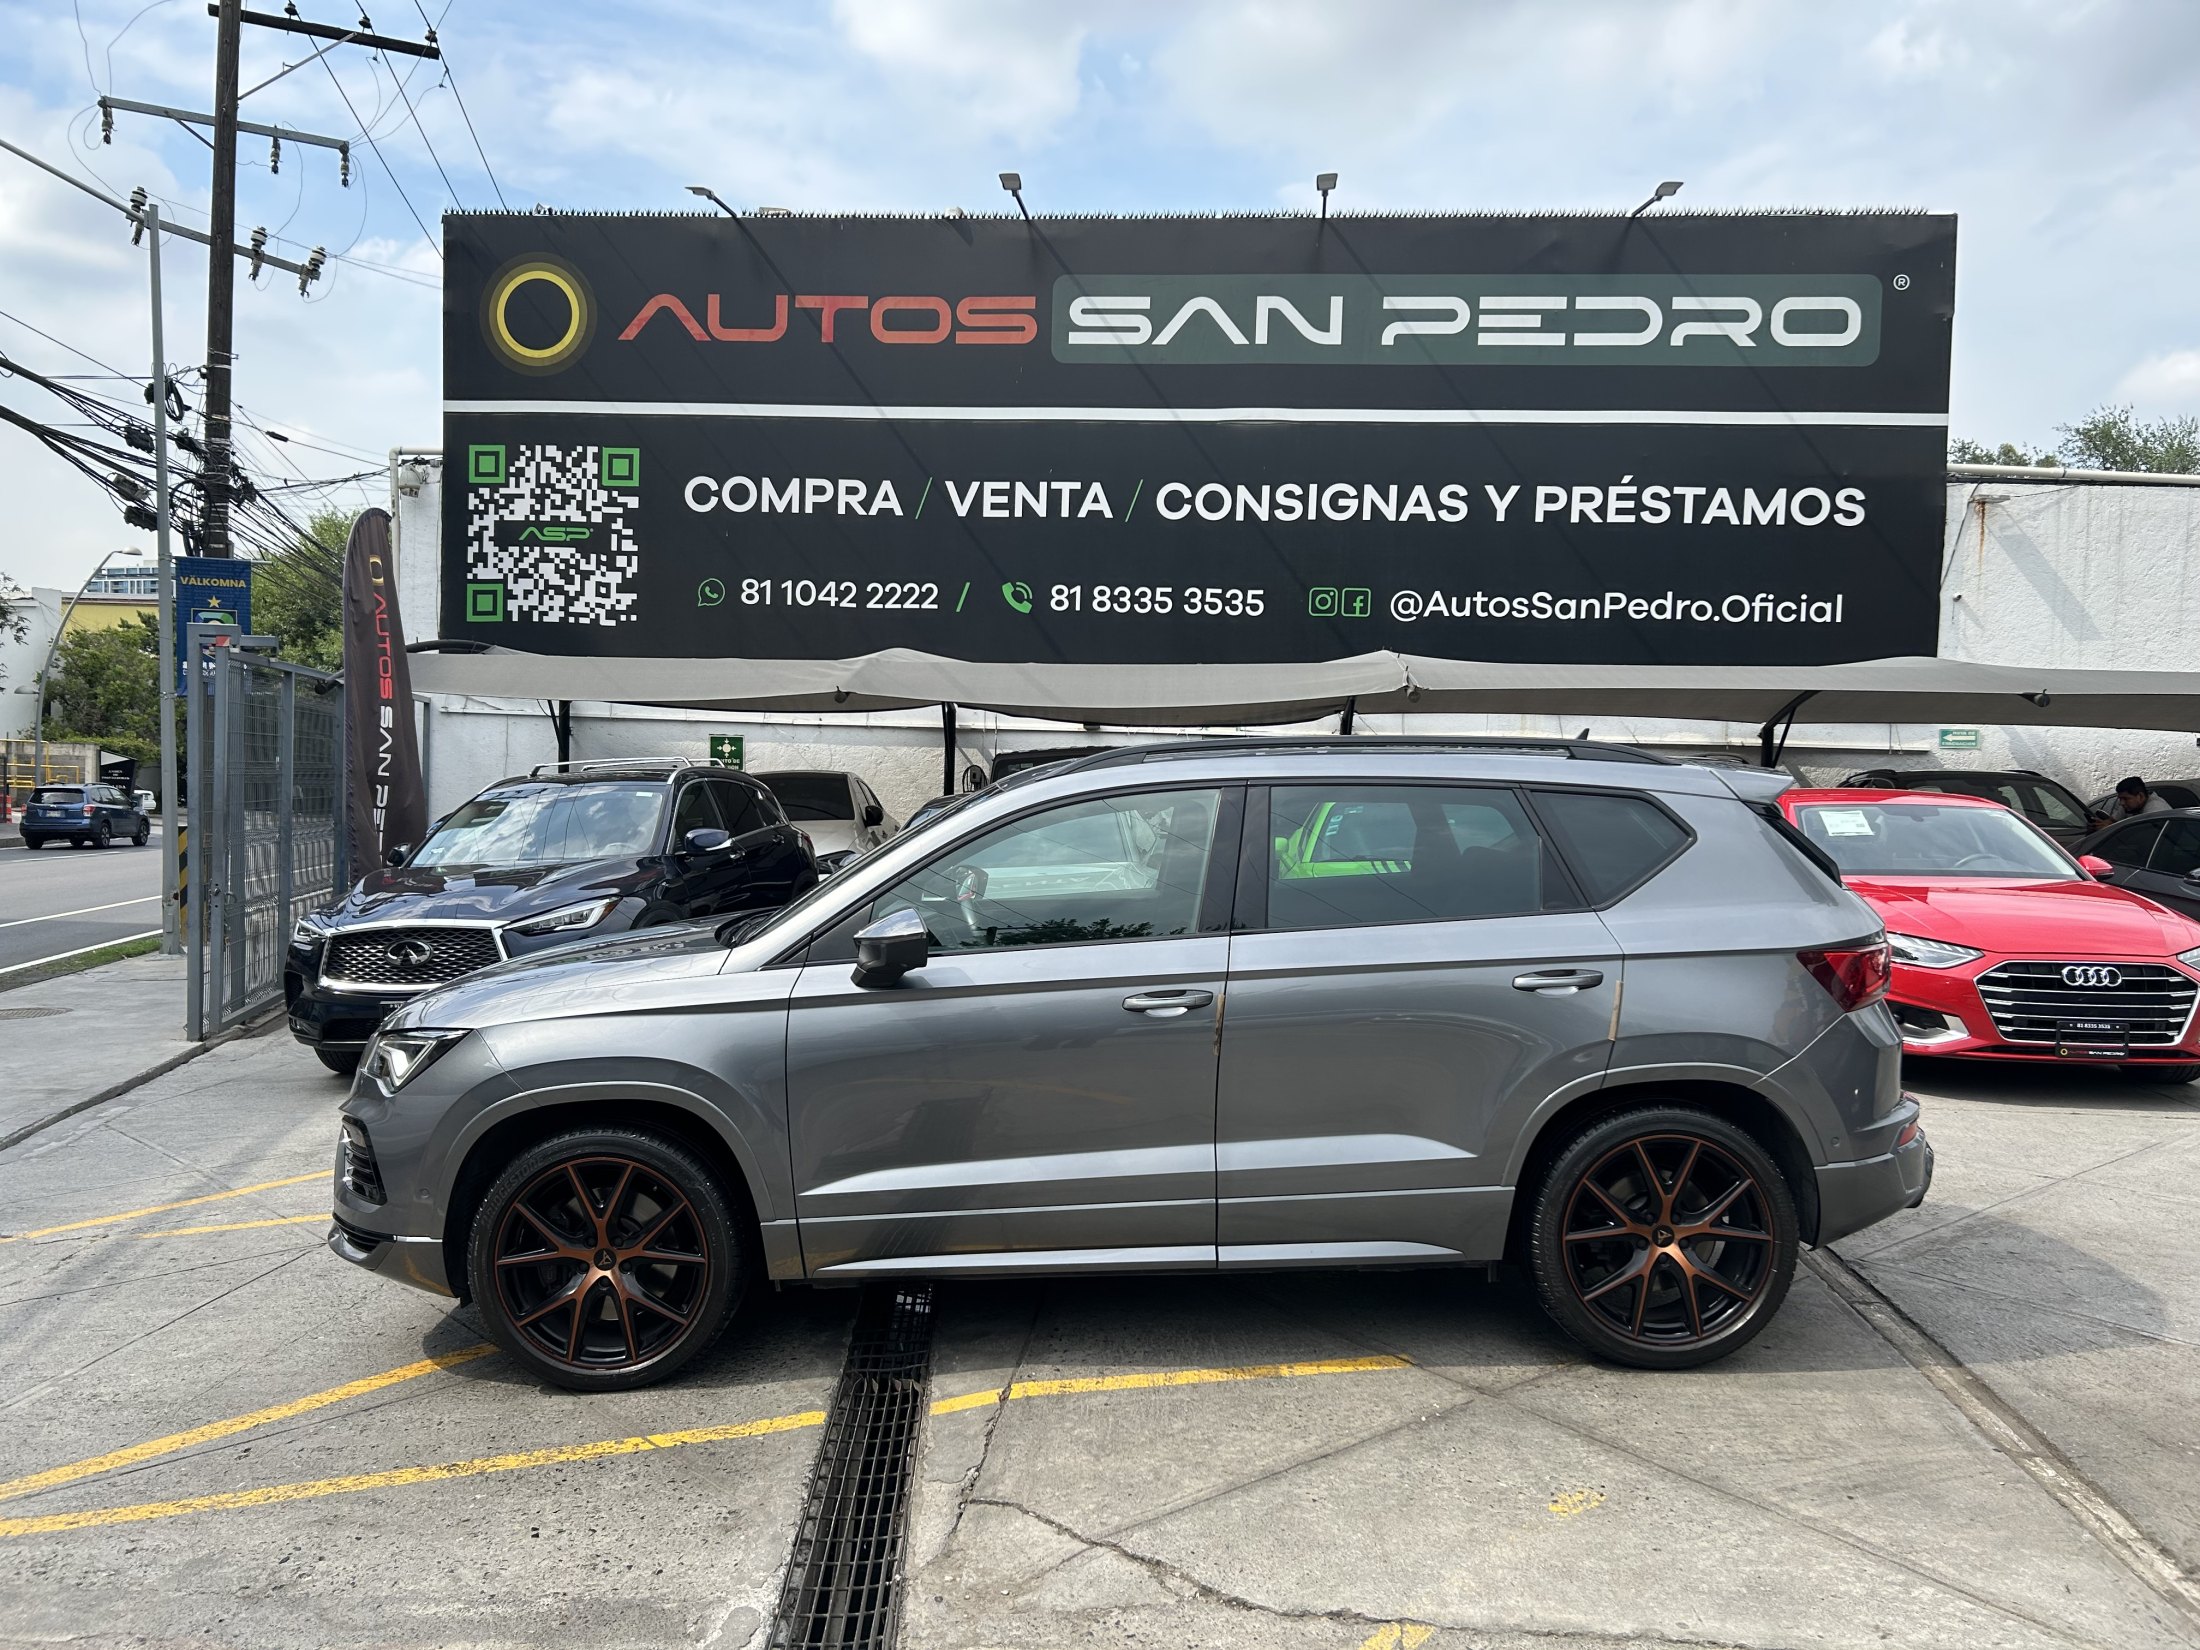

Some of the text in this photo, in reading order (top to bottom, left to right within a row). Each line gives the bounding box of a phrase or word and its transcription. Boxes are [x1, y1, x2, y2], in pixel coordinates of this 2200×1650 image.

[617, 294, 1038, 344] AUTOS
[1067, 295, 1344, 346] SAN
[1380, 295, 1863, 347] PEDRO
[683, 475, 904, 517] COMPRA
[944, 479, 1114, 520] VENTA
[1155, 481, 1469, 524] CONSIGNAS
[1484, 484, 1522, 523] Y
[1534, 474, 1867, 528] PRÉSTAMOS
[518, 526, 592, 542] ASP
[179, 575, 247, 588] VÄLKOMNA
[740, 578, 772, 606] 81
[781, 579, 858, 608] 1042
[866, 581, 939, 610] 2222
[1050, 584, 1266, 617] 81 8335 3535
[1389, 589, 1844, 624] @AutosSanPedro.Oficial
[373, 591, 394, 700] AUTOS
[378, 705, 393, 777] SAN
